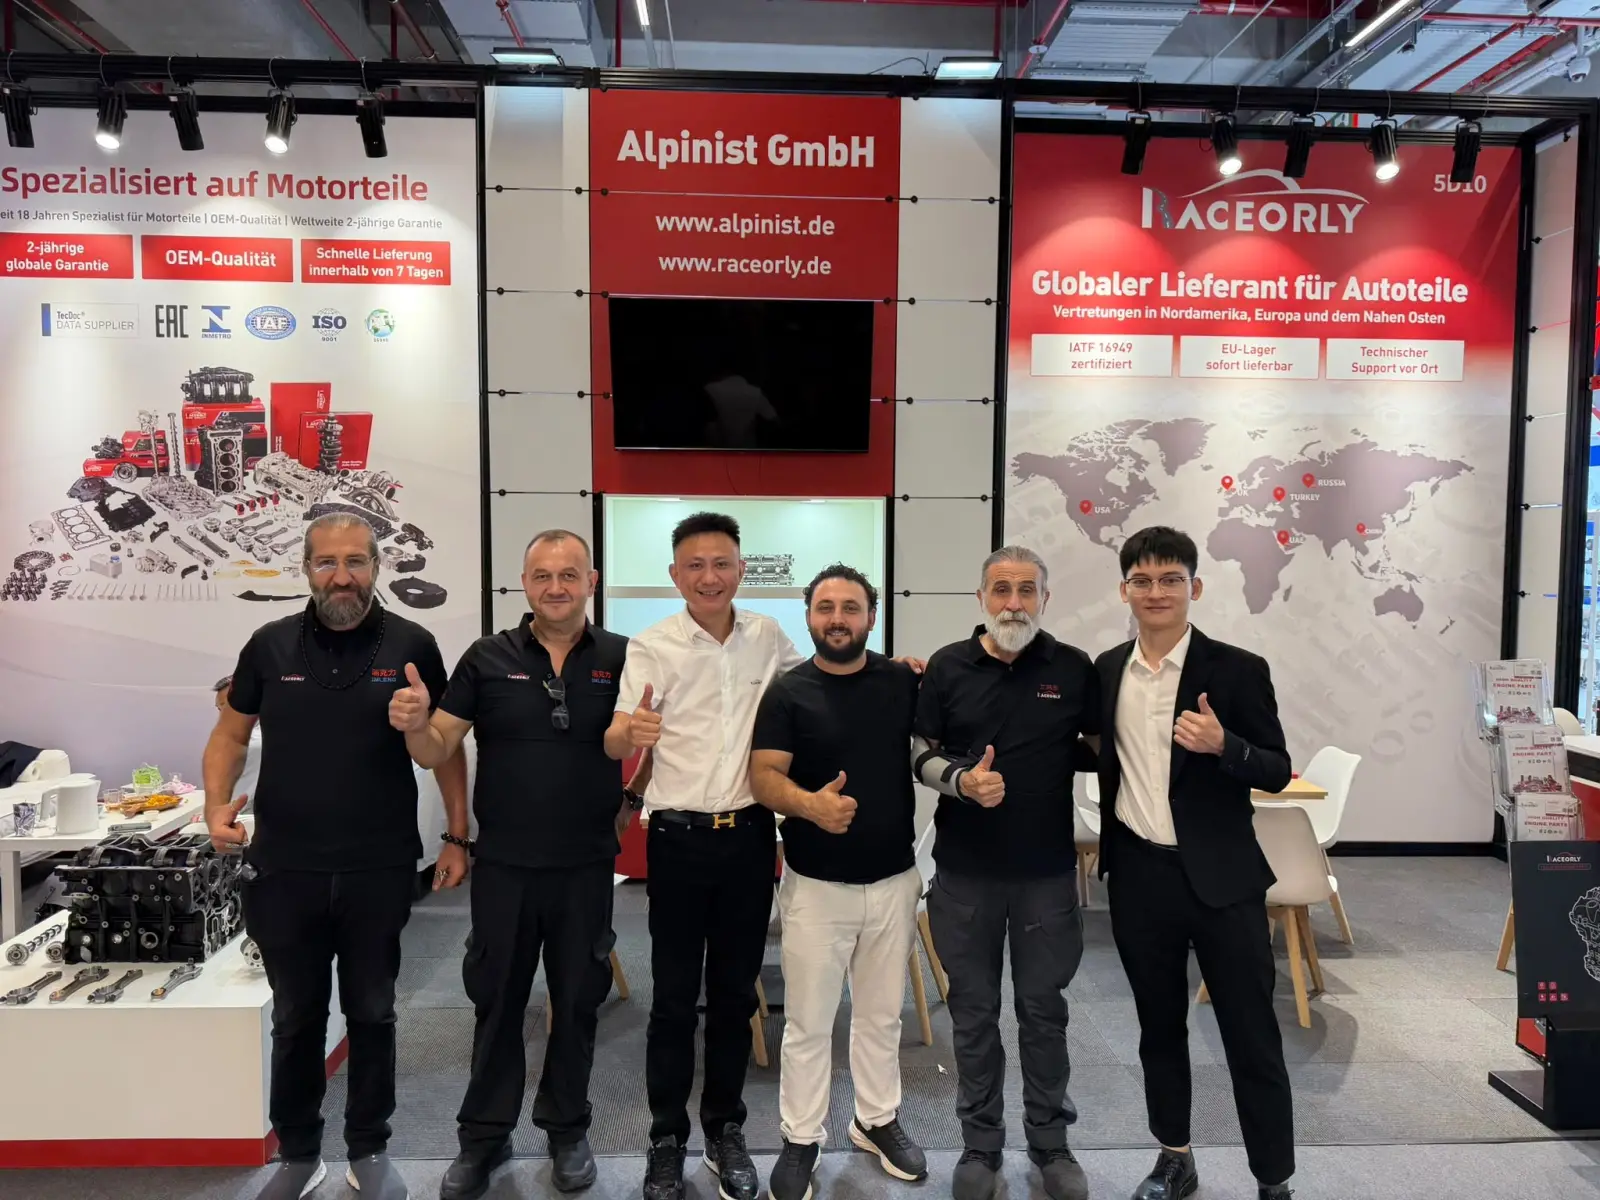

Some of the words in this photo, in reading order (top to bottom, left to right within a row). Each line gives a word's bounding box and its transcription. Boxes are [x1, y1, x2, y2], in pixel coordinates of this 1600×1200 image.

[617, 129, 758, 170] Alpinist
[767, 134, 875, 168] GmbH
[1, 166, 198, 200] Spezialisiert
[206, 171, 259, 197] auf
[267, 173, 428, 201] Motorteile
[1141, 187, 1365, 234] RACEORLY
[17, 209, 30, 220] 18
[32, 210, 70, 221] Jahren
[72, 210, 125, 223] Spezialist
[127, 211, 143, 222] für
[146, 212, 201, 224] Motorteile
[211, 213, 282, 226] OEM-Qualität
[291, 216, 344, 227] Weltweite
[346, 216, 395, 230] 2-jährige
[397, 217, 443, 229] Garantie
[655, 213, 835, 238] www.alpinist.de
[27, 241, 84, 255] 2-jährige
[316, 247, 370, 260] Schnelle
[373, 248, 432, 263] Lieferung
[6, 258, 52, 272] globale
[55, 259, 109, 271] Garantie
[165, 249, 276, 268] OEM-Qualität
[309, 264, 369, 277] innerhalb
[371, 266, 394, 277] von
[396, 266, 404, 277] 7
[407, 265, 444, 280] Tagen
[658, 256, 832, 279] www.raceorly.de
[1032, 270, 1154, 297] Globaler
[1160, 271, 1288, 299] Lieferant
[1294, 274, 1338, 300] für
[1342, 276, 1468, 303] Autoteile
[155, 304, 189, 338] EAC
[1053, 304, 1141, 321] Vertretungen
[1145, 305, 1157, 319] in
[1160, 306, 1252, 323] Nordamerika,
[1255, 308, 1301, 324] Europa
[1304, 309, 1329, 322] und
[1331, 310, 1360, 323] dem
[1364, 311, 1405, 323] Nahen
[1408, 311, 1446, 324] Osten
[56, 321, 82, 330] DATA
[84, 321, 135, 331] SUPPLIER
[255, 316, 289, 331] IAF
[312, 315, 347, 330] ISO
[1069, 342, 1095, 353] IATF
[1099, 342, 1133, 354] 16949
[1221, 343, 1276, 357] EU-Lager
[1360, 346, 1429, 358] Technischer
[1071, 358, 1133, 370] zertifiziert
[1206, 359, 1240, 371] sofort
[1243, 360, 1294, 372] lieferbar
[1351, 362, 1396, 376] Support
[1399, 364, 1418, 374] vor
[1420, 363, 1439, 374] Ort
[1318, 479, 1346, 487] RUSSIA
[1289, 493, 1320, 501] TURKEY
[1094, 506, 1111, 514] USA
